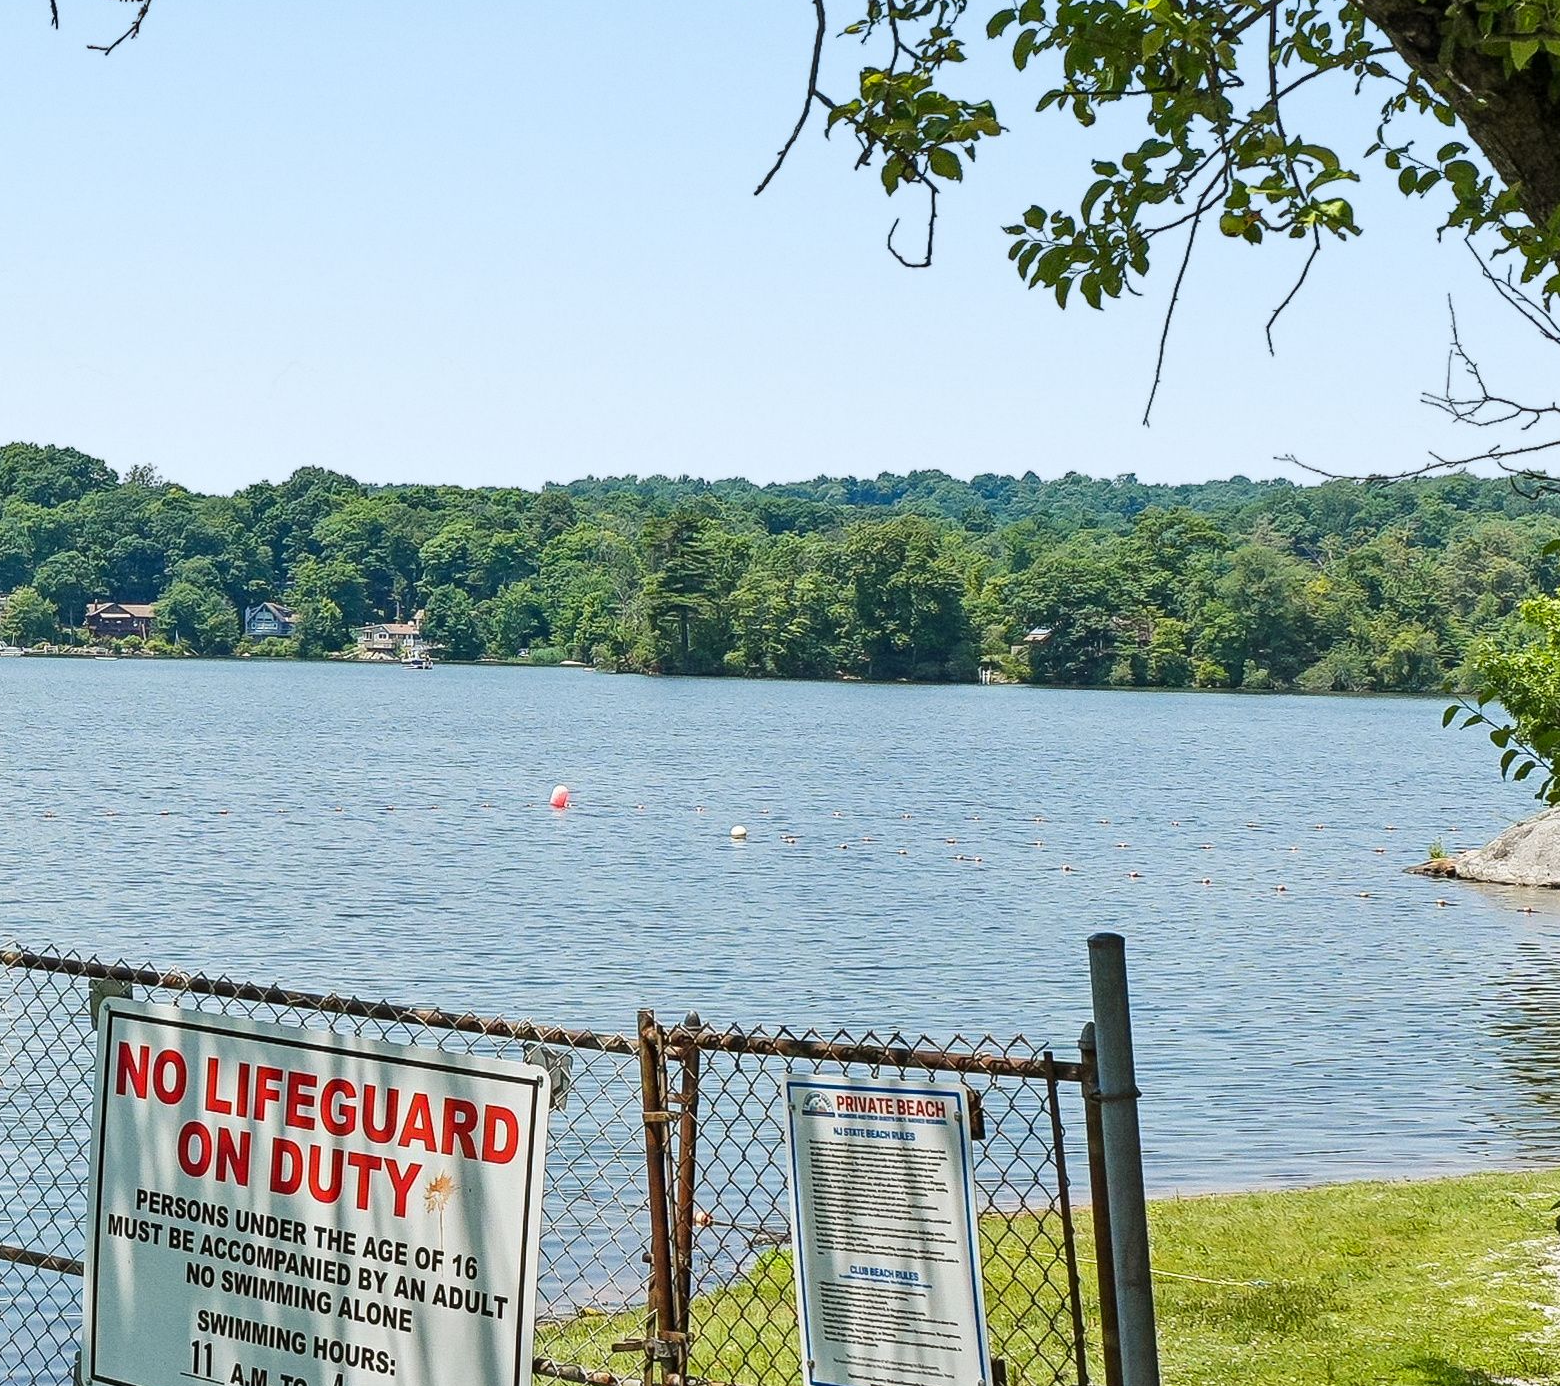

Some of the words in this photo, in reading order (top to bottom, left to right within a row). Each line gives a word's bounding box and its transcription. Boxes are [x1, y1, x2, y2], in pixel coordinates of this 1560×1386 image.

[115, 1041, 187, 1105] NO
[206, 1057, 518, 1164] LIFEGUARD
[837, 1096, 894, 1114] PRIVATE
[897, 1099, 946, 1118] BEACH
[844, 1128, 865, 1138] STATE
[866, 1129, 890, 1139] BEACH
[892, 1131, 915, 1141] RULES
[178, 1122, 251, 1187] ON
[270, 1137, 422, 1218] DUTY
[108, 1214, 163, 1245] MUST
[169, 1227, 194, 1253] BE
[200, 1234, 350, 1286] ACCOMPANIED
[359, 1268, 388, 1293] BY
[394, 1276, 425, 1302] AN
[432, 1284, 508, 1319] ADULT
[136, 1189, 228, 1228] PERSONS
[236, 1210, 306, 1245] UNDER
[314, 1226, 356, 1255] THE
[363, 1237, 407, 1266] AGE
[416, 1247, 444, 1272] OF
[453, 1255, 477, 1280] 16
[187, 1262, 214, 1288] NO
[222, 1270, 331, 1314] SWIMMING
[338, 1296, 412, 1332] ALONE
[850, 1265, 868, 1275] CLUB
[870, 1268, 894, 1278] BEACH
[896, 1271, 918, 1281] RULES
[190, 1339, 215, 1379] 11
[198, 1310, 306, 1355] SWIMMING
[314, 1336, 395, 1376] HOURS:
